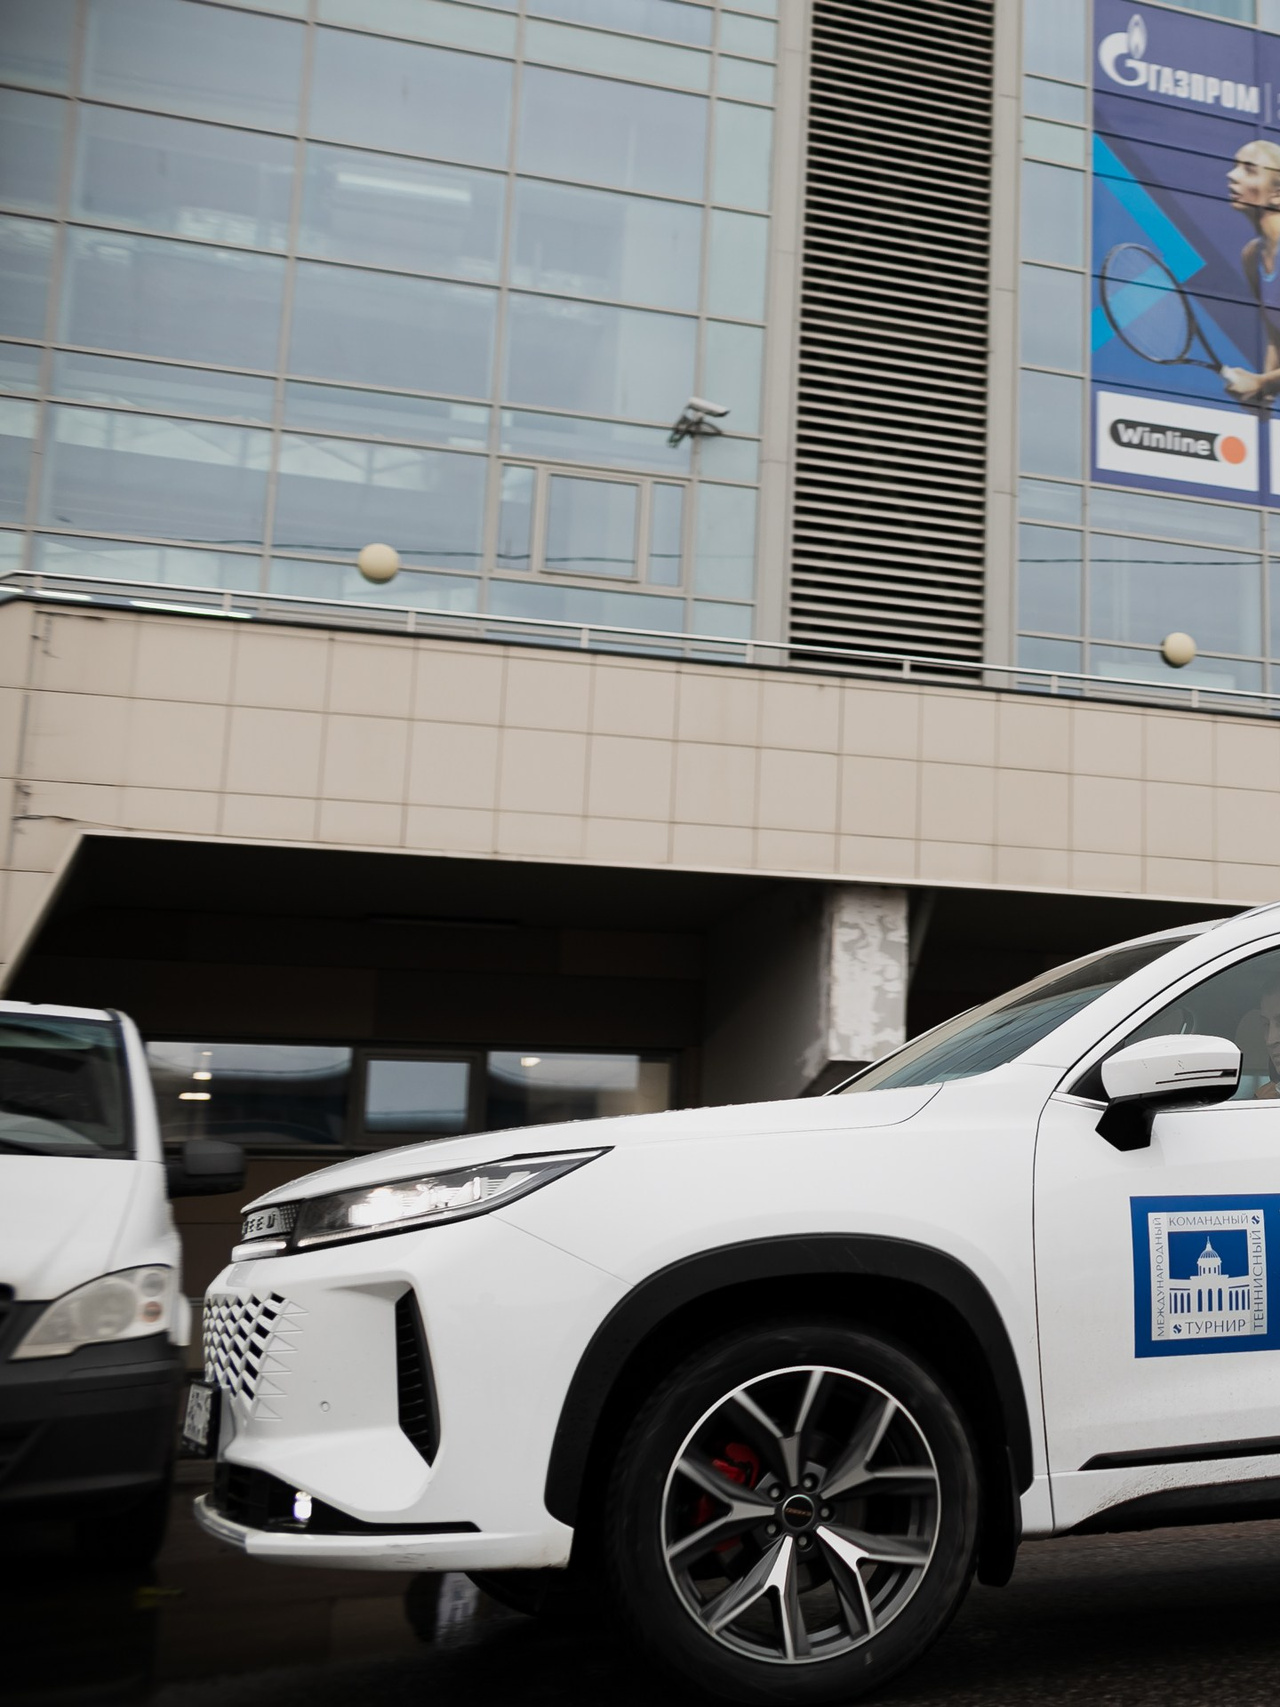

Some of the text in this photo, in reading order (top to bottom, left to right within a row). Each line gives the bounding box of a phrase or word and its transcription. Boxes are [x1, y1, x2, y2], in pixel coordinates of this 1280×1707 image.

[1147, 62, 1260, 114] ГАЗПРОМ
[1115, 422, 1212, 456] Winline
[1168, 1213, 1249, 1226] КОМАНДНЫЙ
[1152, 1216, 1166, 1337] МЕЖДУНАРОДНЫЙ
[1249, 1229, 1264, 1331] ТЕННИСНЫЙ
[1185, 1319, 1246, 1334] ТУРНИР
